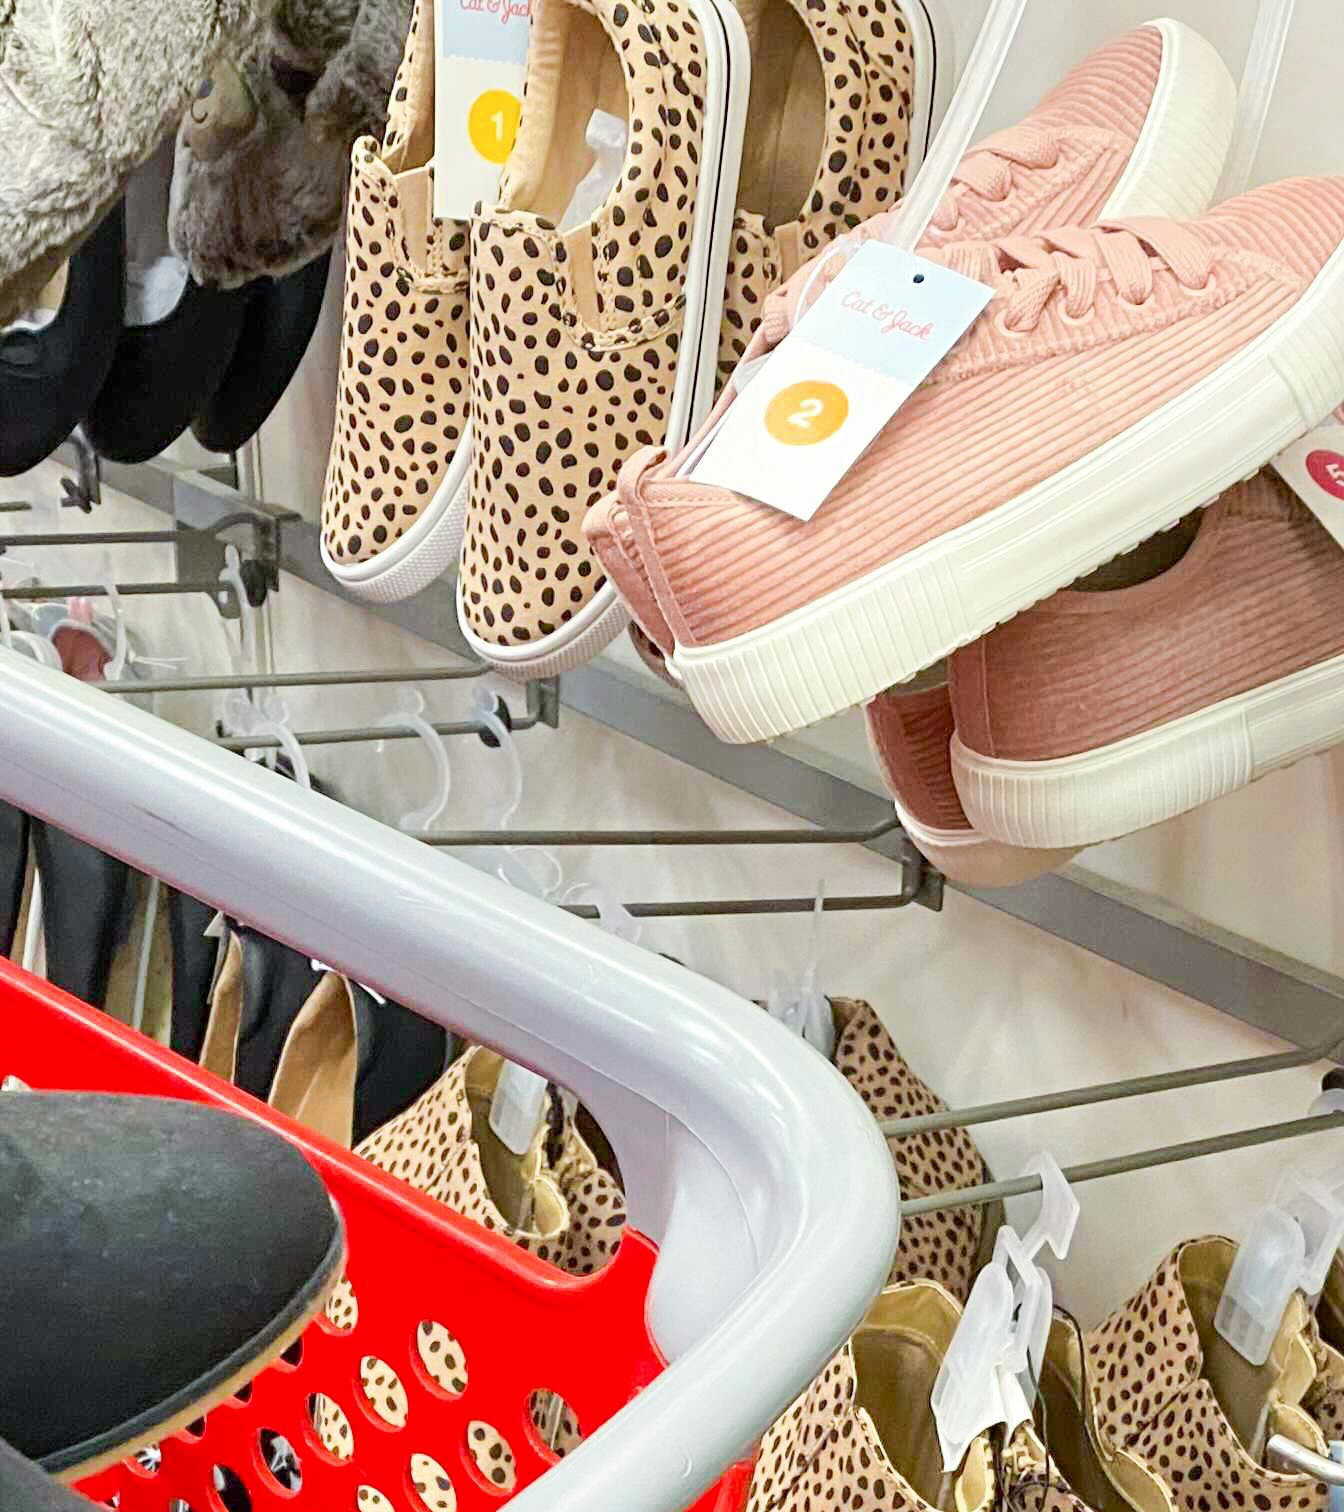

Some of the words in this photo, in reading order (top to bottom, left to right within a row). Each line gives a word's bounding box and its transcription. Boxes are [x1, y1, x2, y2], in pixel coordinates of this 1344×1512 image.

[501, 0, 529, 24] Jac
[490, 112, 504, 142] 1
[841, 290, 875, 314] Cat
[871, 303, 894, 321] &
[880, 309, 935, 341] Jack
[787, 397, 825, 429] 2
